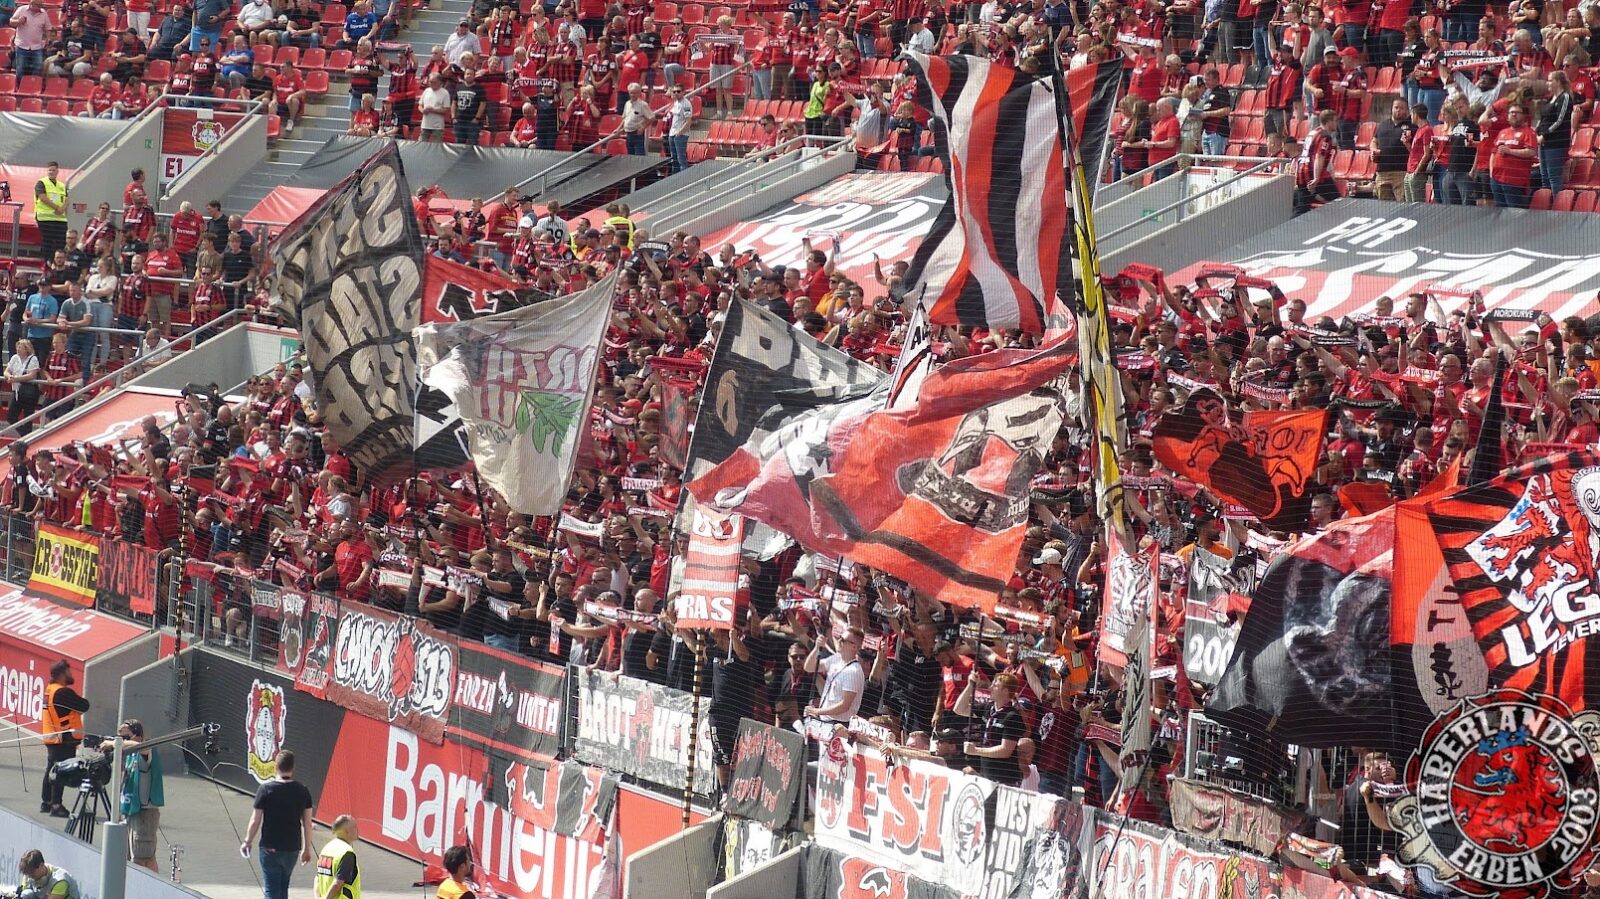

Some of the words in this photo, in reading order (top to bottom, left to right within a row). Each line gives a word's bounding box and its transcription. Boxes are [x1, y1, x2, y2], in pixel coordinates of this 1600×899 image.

[165, 157, 183, 178] E1
[454, 672, 496, 715] FORZA
[847, 753, 951, 860] FSI
